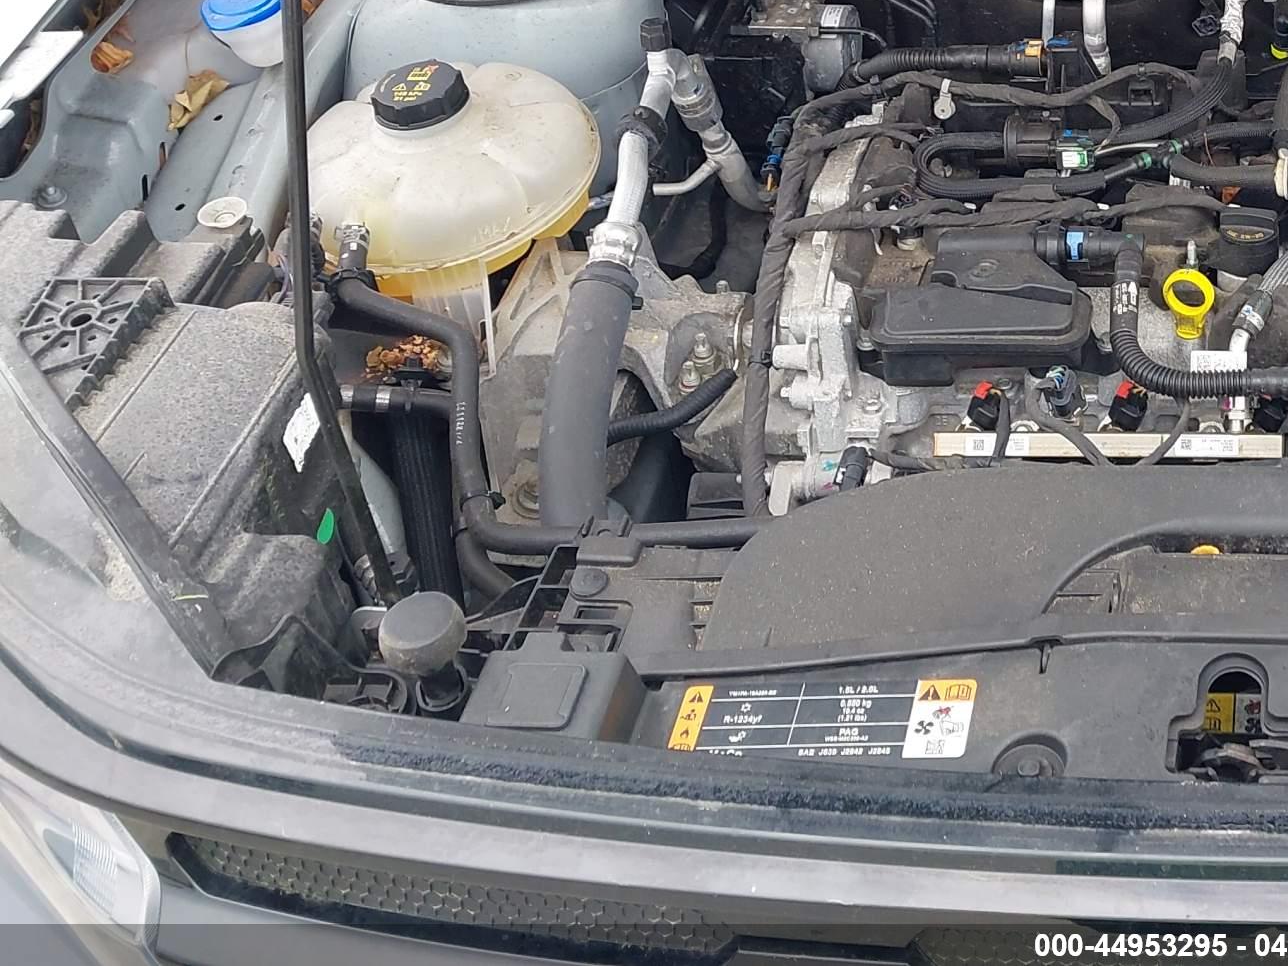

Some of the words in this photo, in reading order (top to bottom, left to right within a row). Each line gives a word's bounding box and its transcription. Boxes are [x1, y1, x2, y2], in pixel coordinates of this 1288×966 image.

[861, 699, 872, 708] kg
[723, 715, 763, 725] R-1234yf
[839, 727, 859, 736] PAG
